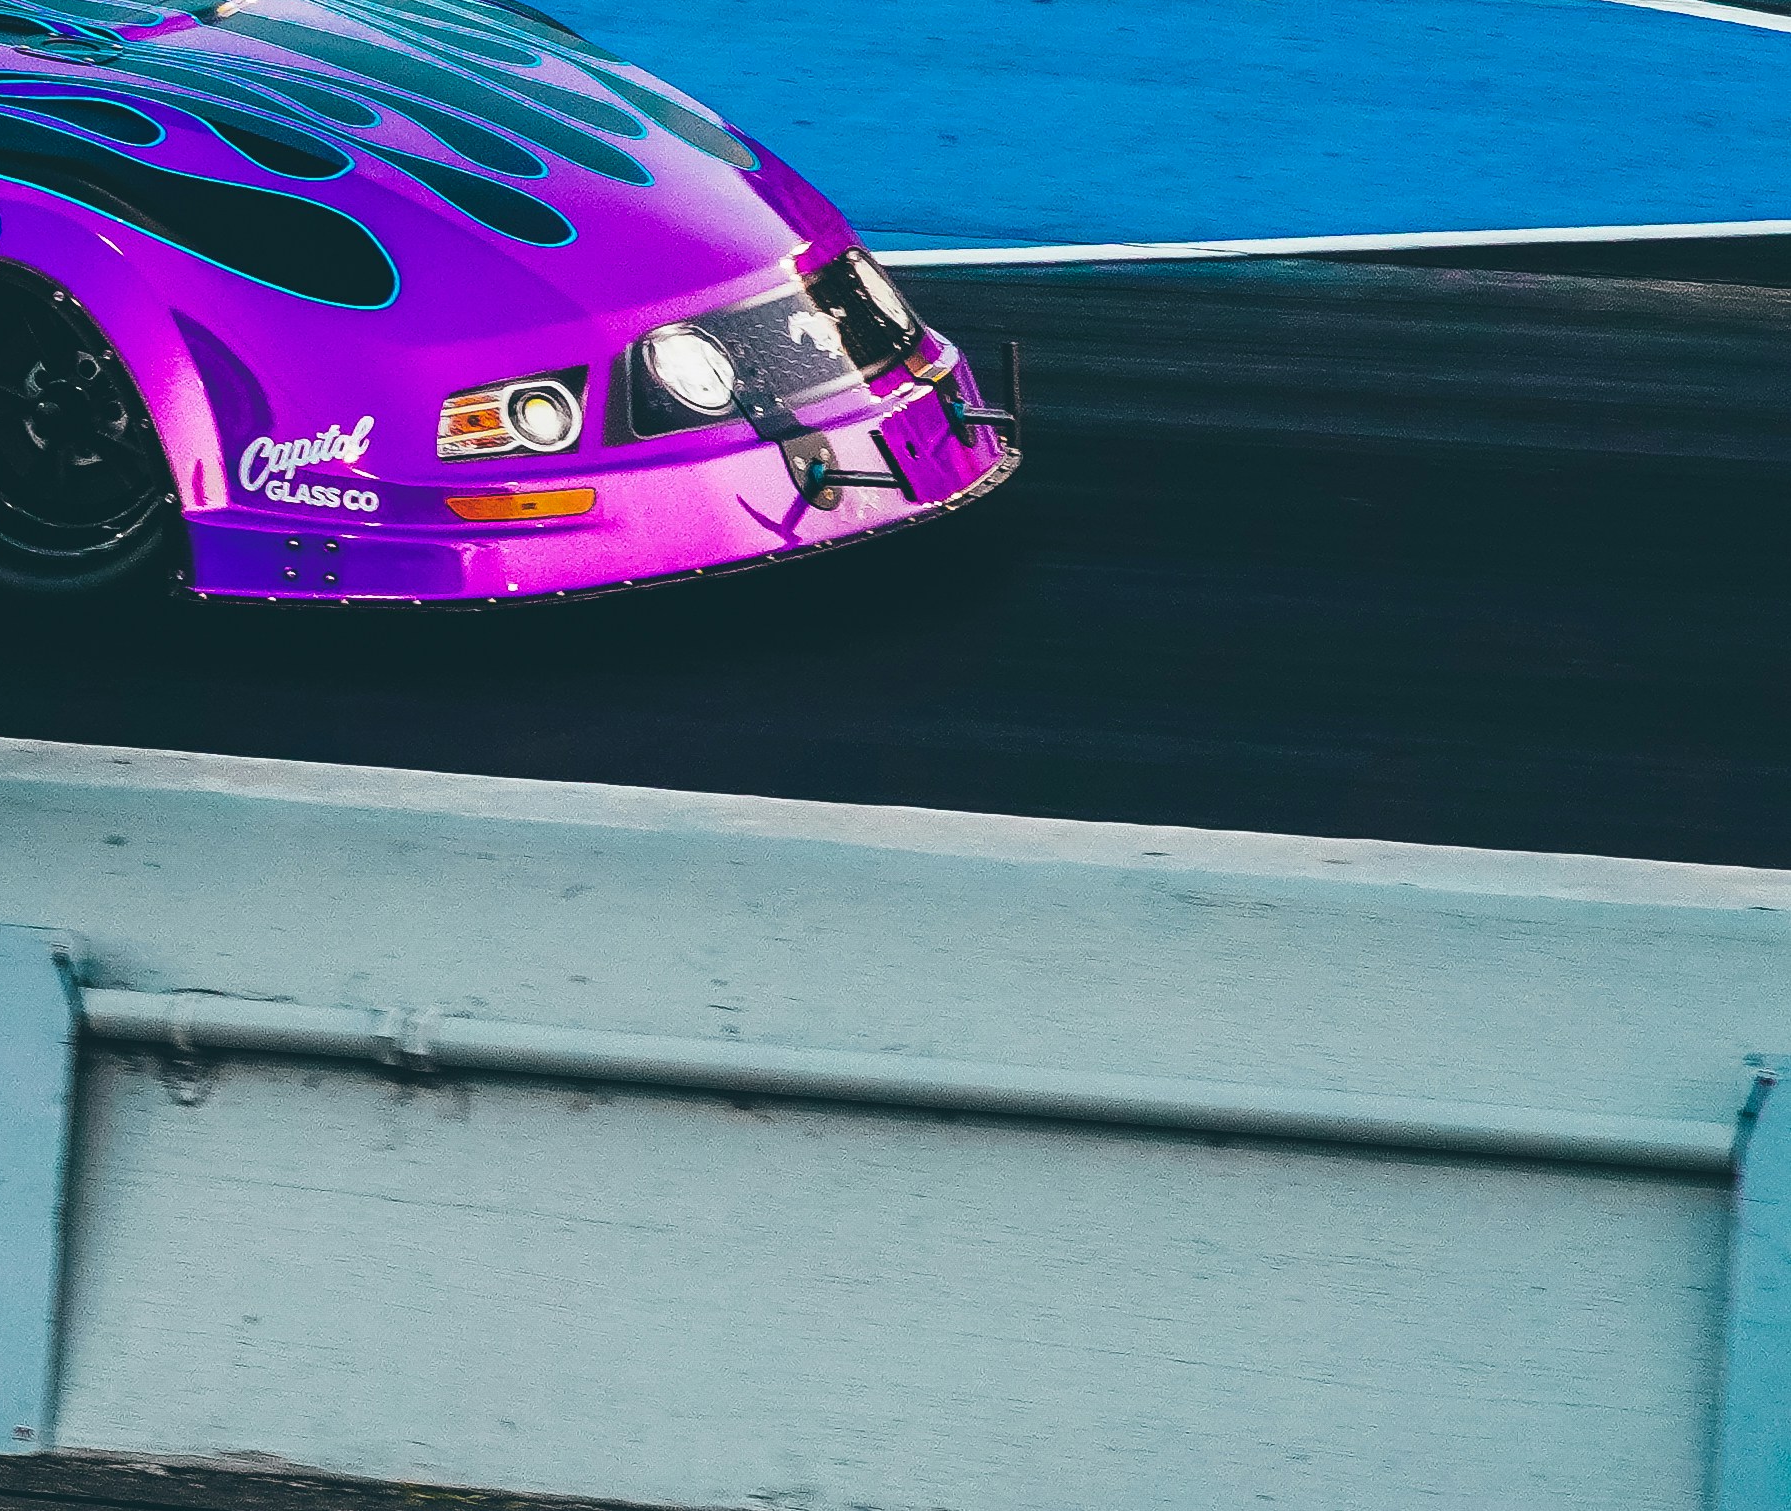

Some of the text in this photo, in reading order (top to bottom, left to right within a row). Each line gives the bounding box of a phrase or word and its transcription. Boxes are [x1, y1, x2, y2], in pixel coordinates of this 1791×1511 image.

[238, 415, 376, 492] Capitol
[264, 480, 380, 512] GLASS CO
